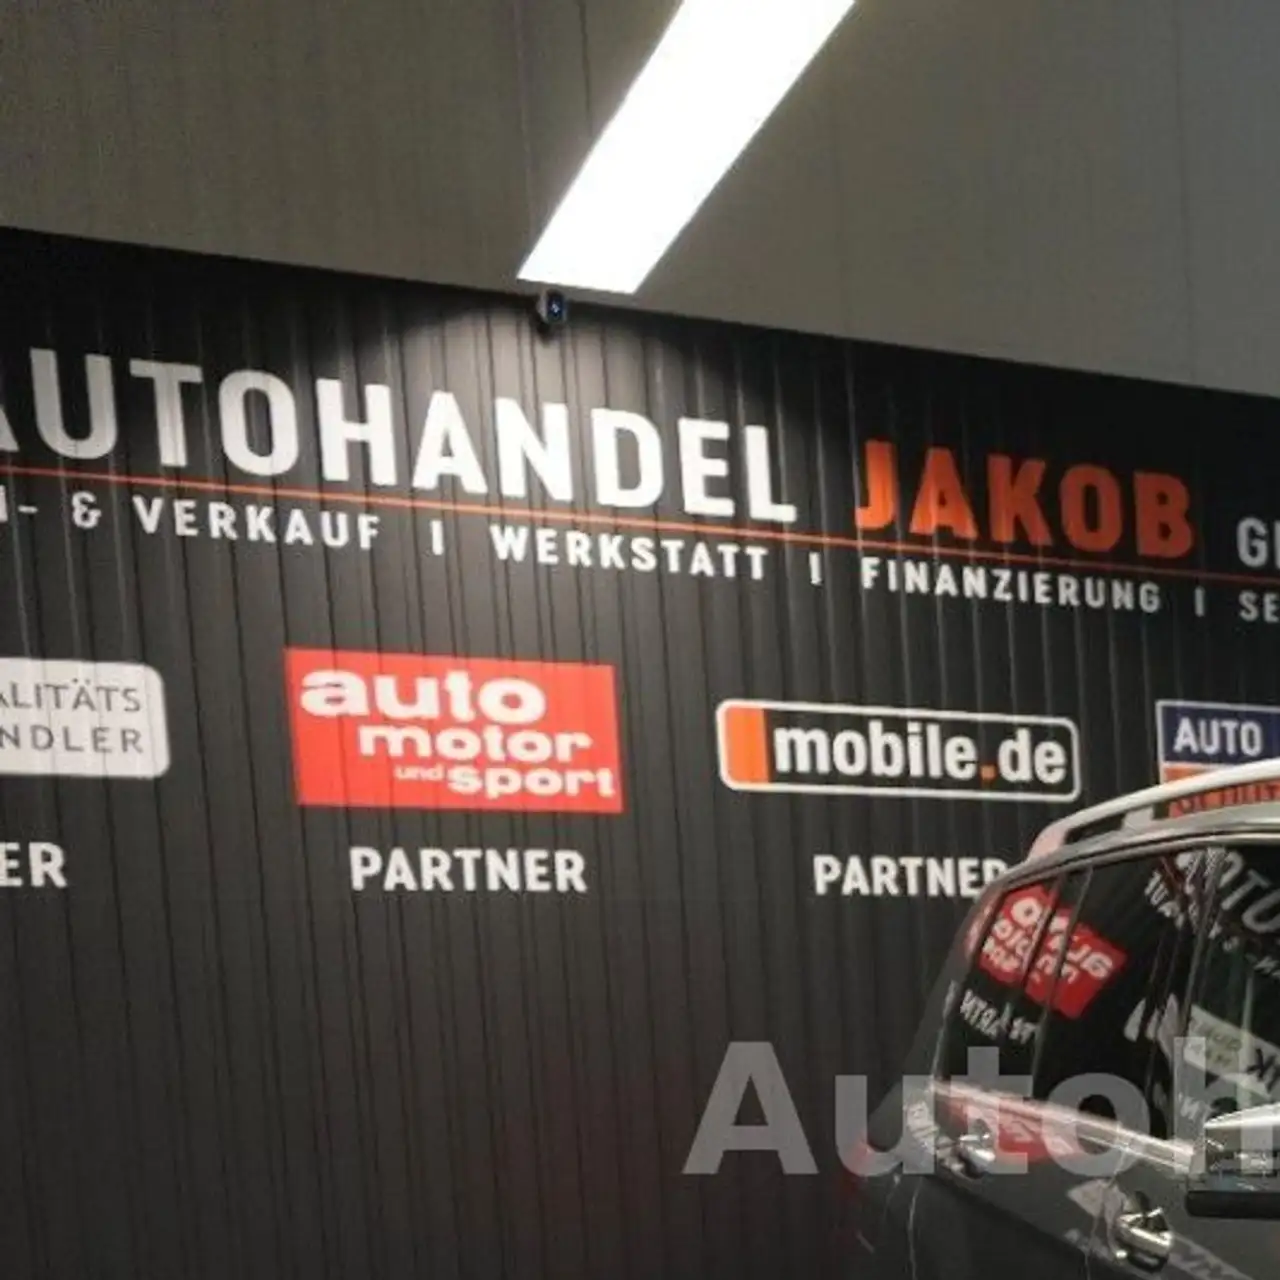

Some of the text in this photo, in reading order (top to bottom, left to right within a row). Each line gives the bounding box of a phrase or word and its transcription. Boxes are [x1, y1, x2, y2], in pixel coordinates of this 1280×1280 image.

[855, 438, 1195, 559] JAKOB
[72, 490, 101, 529] &
[132, 494, 381, 551] VERKAUF
[490, 523, 769, 580] WERKSTATT
[860, 558, 1161, 614] FINANZIERUNG
[300, 668, 547, 726] auto
[359, 721, 592, 764] motor
[773, 711, 1066, 784] mobile.de
[1173, 716, 1264, 757] AUTO
[395, 764, 616, 799] und sport
[350, 846, 588, 894] PARTNER
